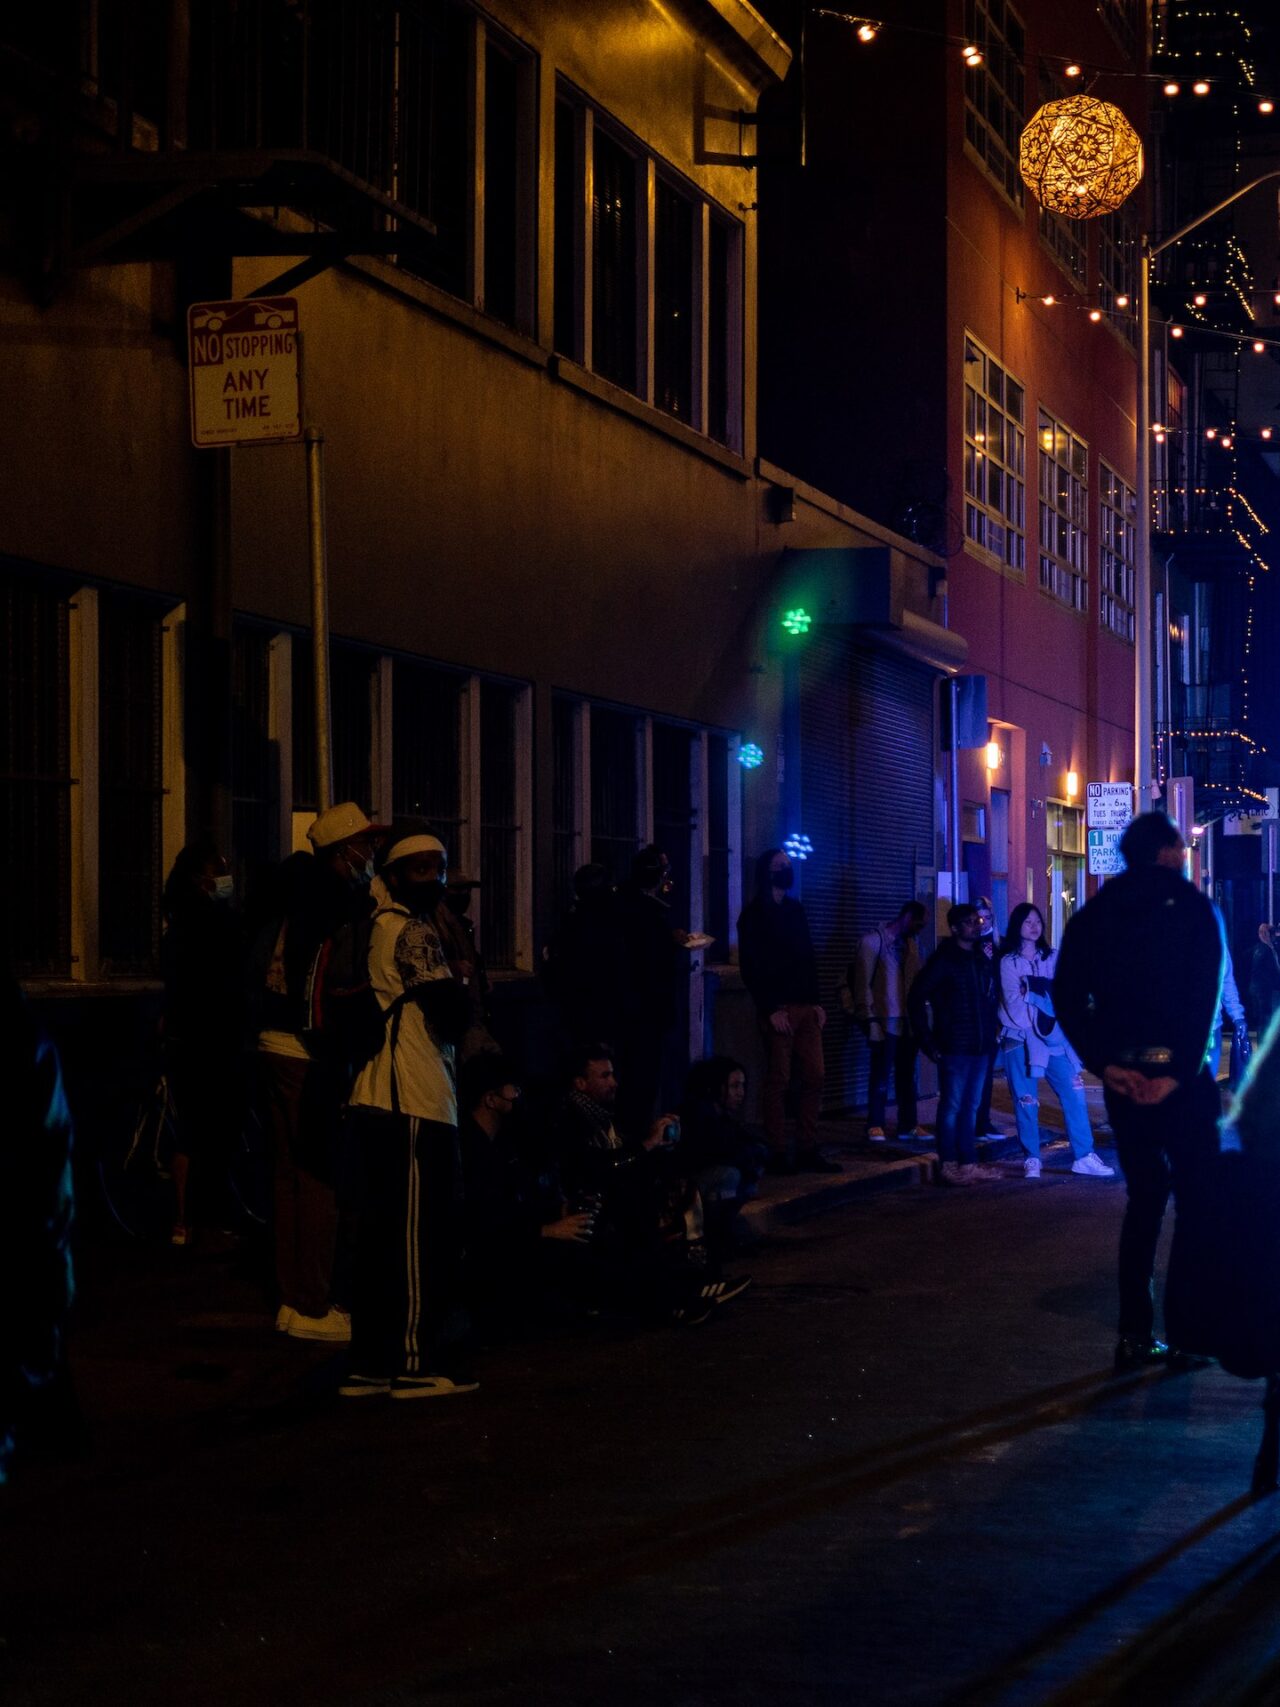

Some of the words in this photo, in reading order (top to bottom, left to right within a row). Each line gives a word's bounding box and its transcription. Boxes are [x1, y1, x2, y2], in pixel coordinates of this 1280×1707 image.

[194, 333, 220, 364] NO
[226, 333, 292, 359] STOPPING
[223, 369, 268, 393] ANY
[223, 396, 271, 420] TIME
[1089, 784, 1101, 797] NO
[1103, 787, 1129, 797] PARKING
[1093, 810, 1106, 818] TUES
